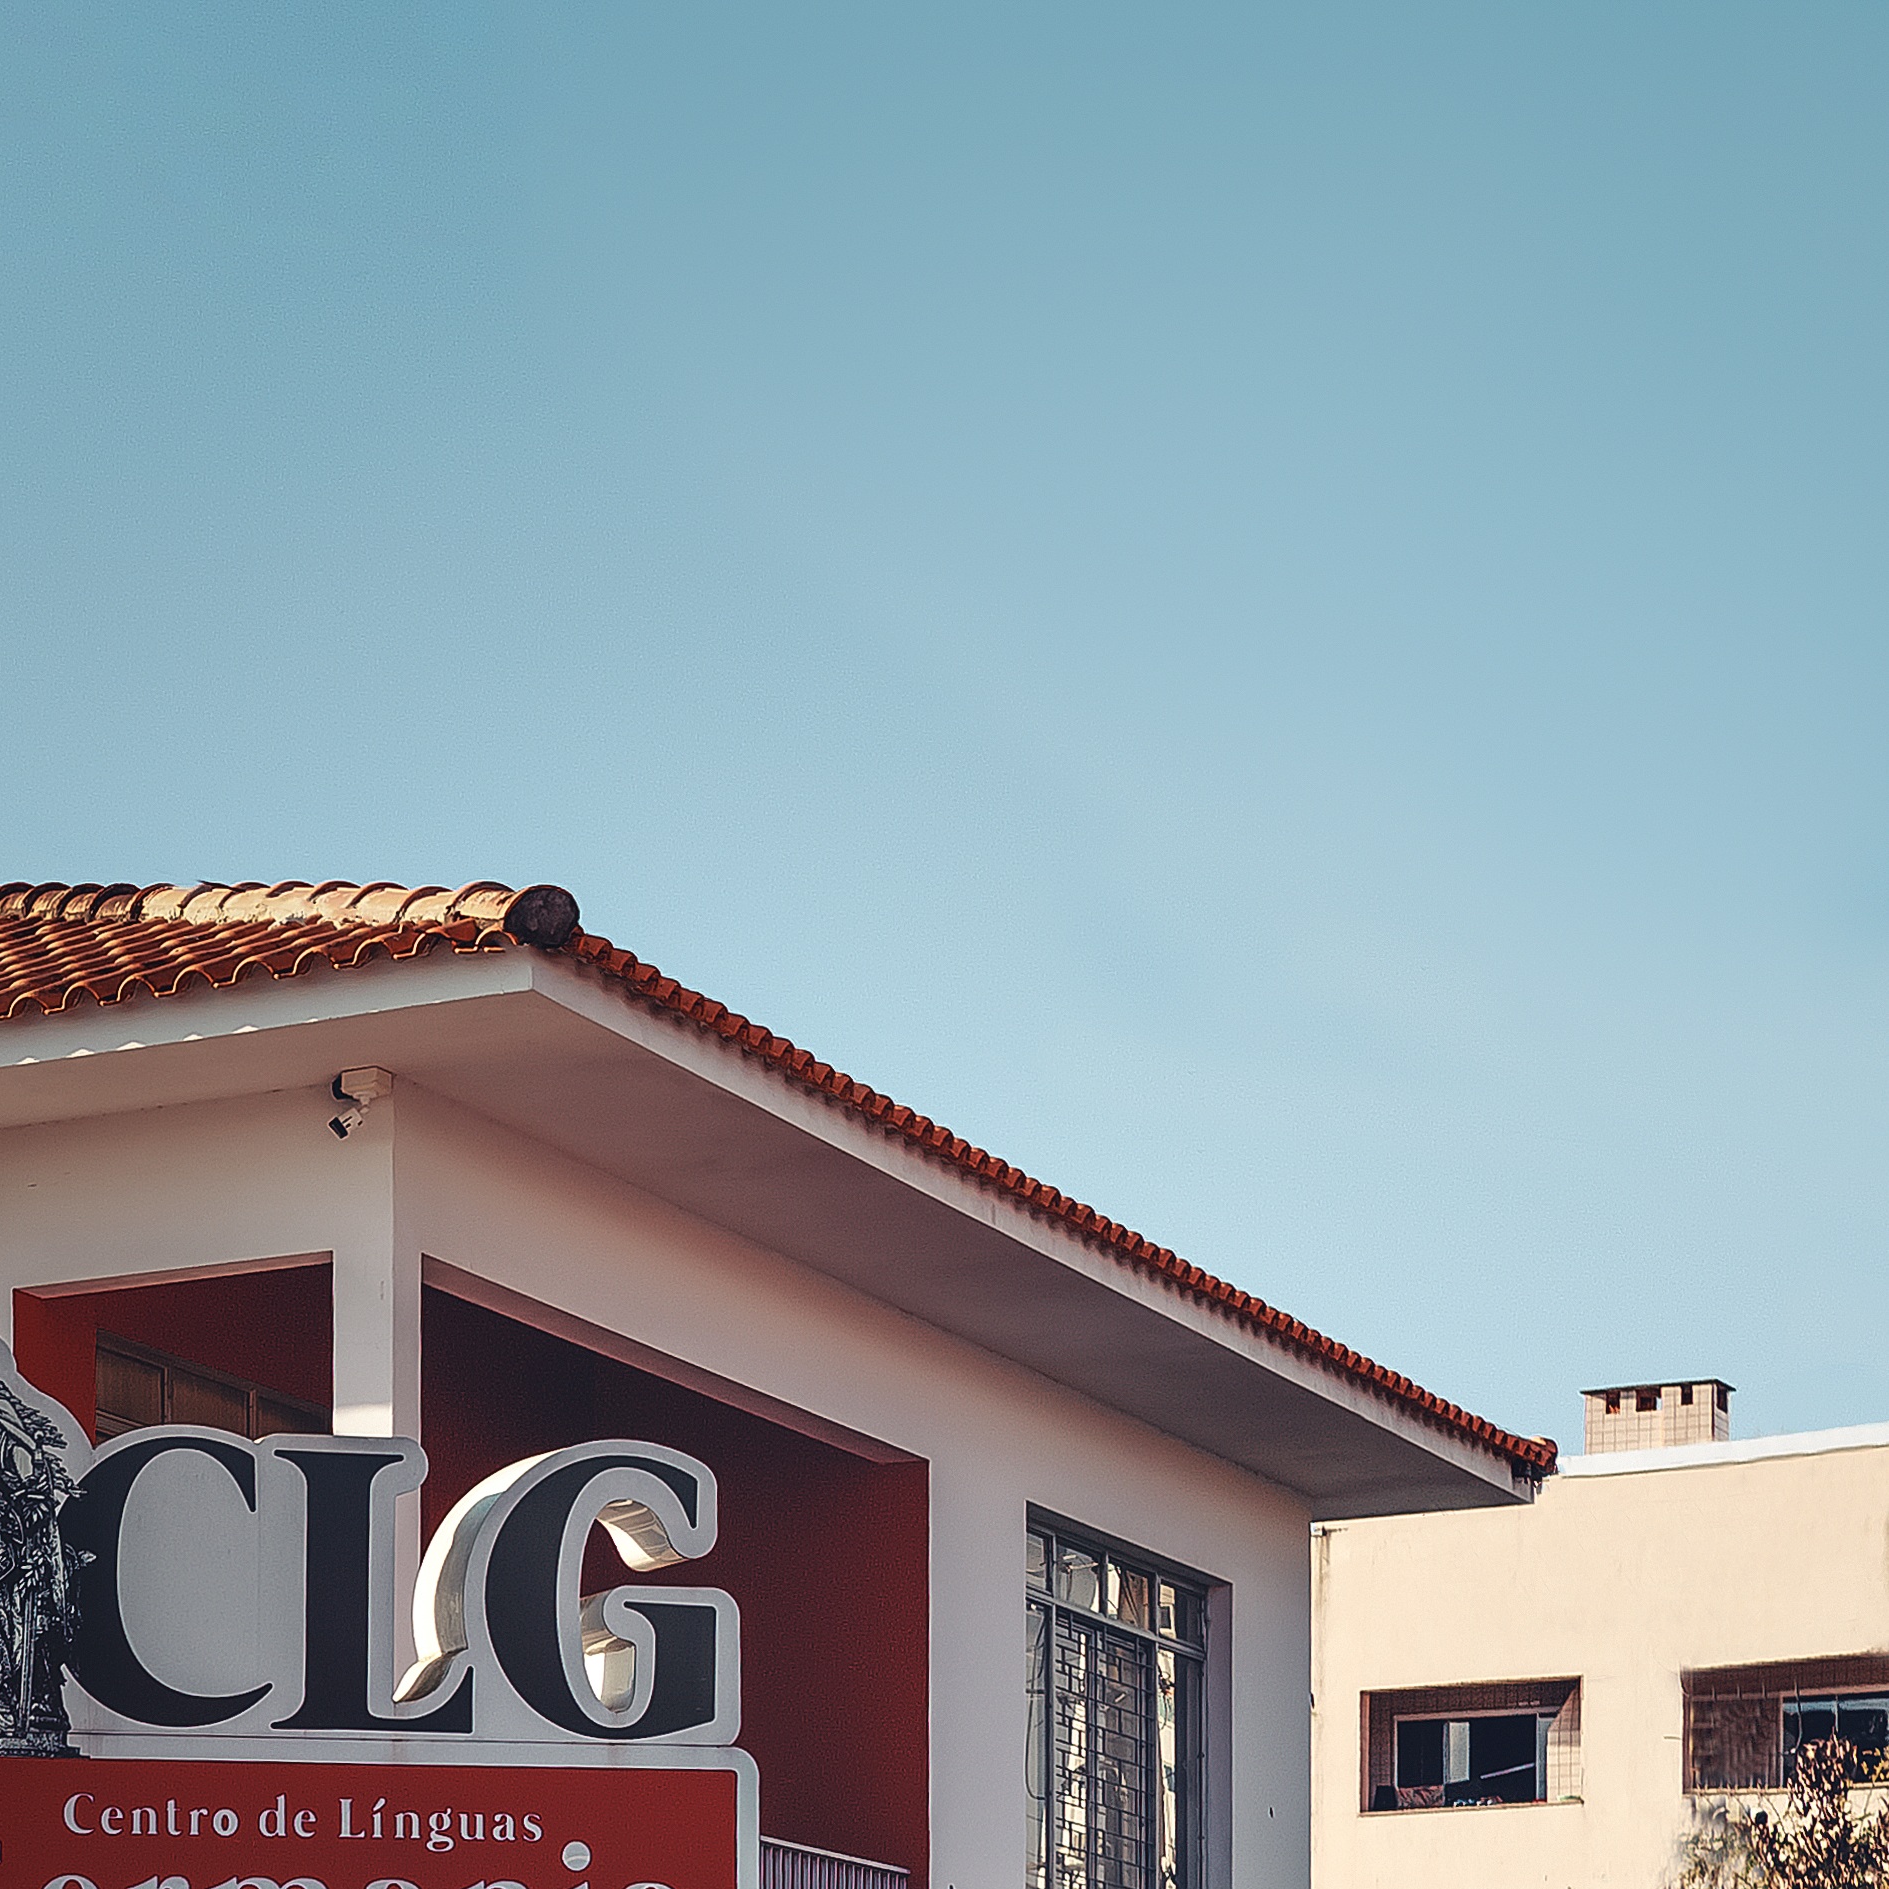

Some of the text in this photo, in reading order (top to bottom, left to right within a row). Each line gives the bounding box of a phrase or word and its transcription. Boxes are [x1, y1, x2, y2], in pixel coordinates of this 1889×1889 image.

[58, 1435, 716, 1740] CLG
[63, 1793, 543, 1852] Centro de Línguas
